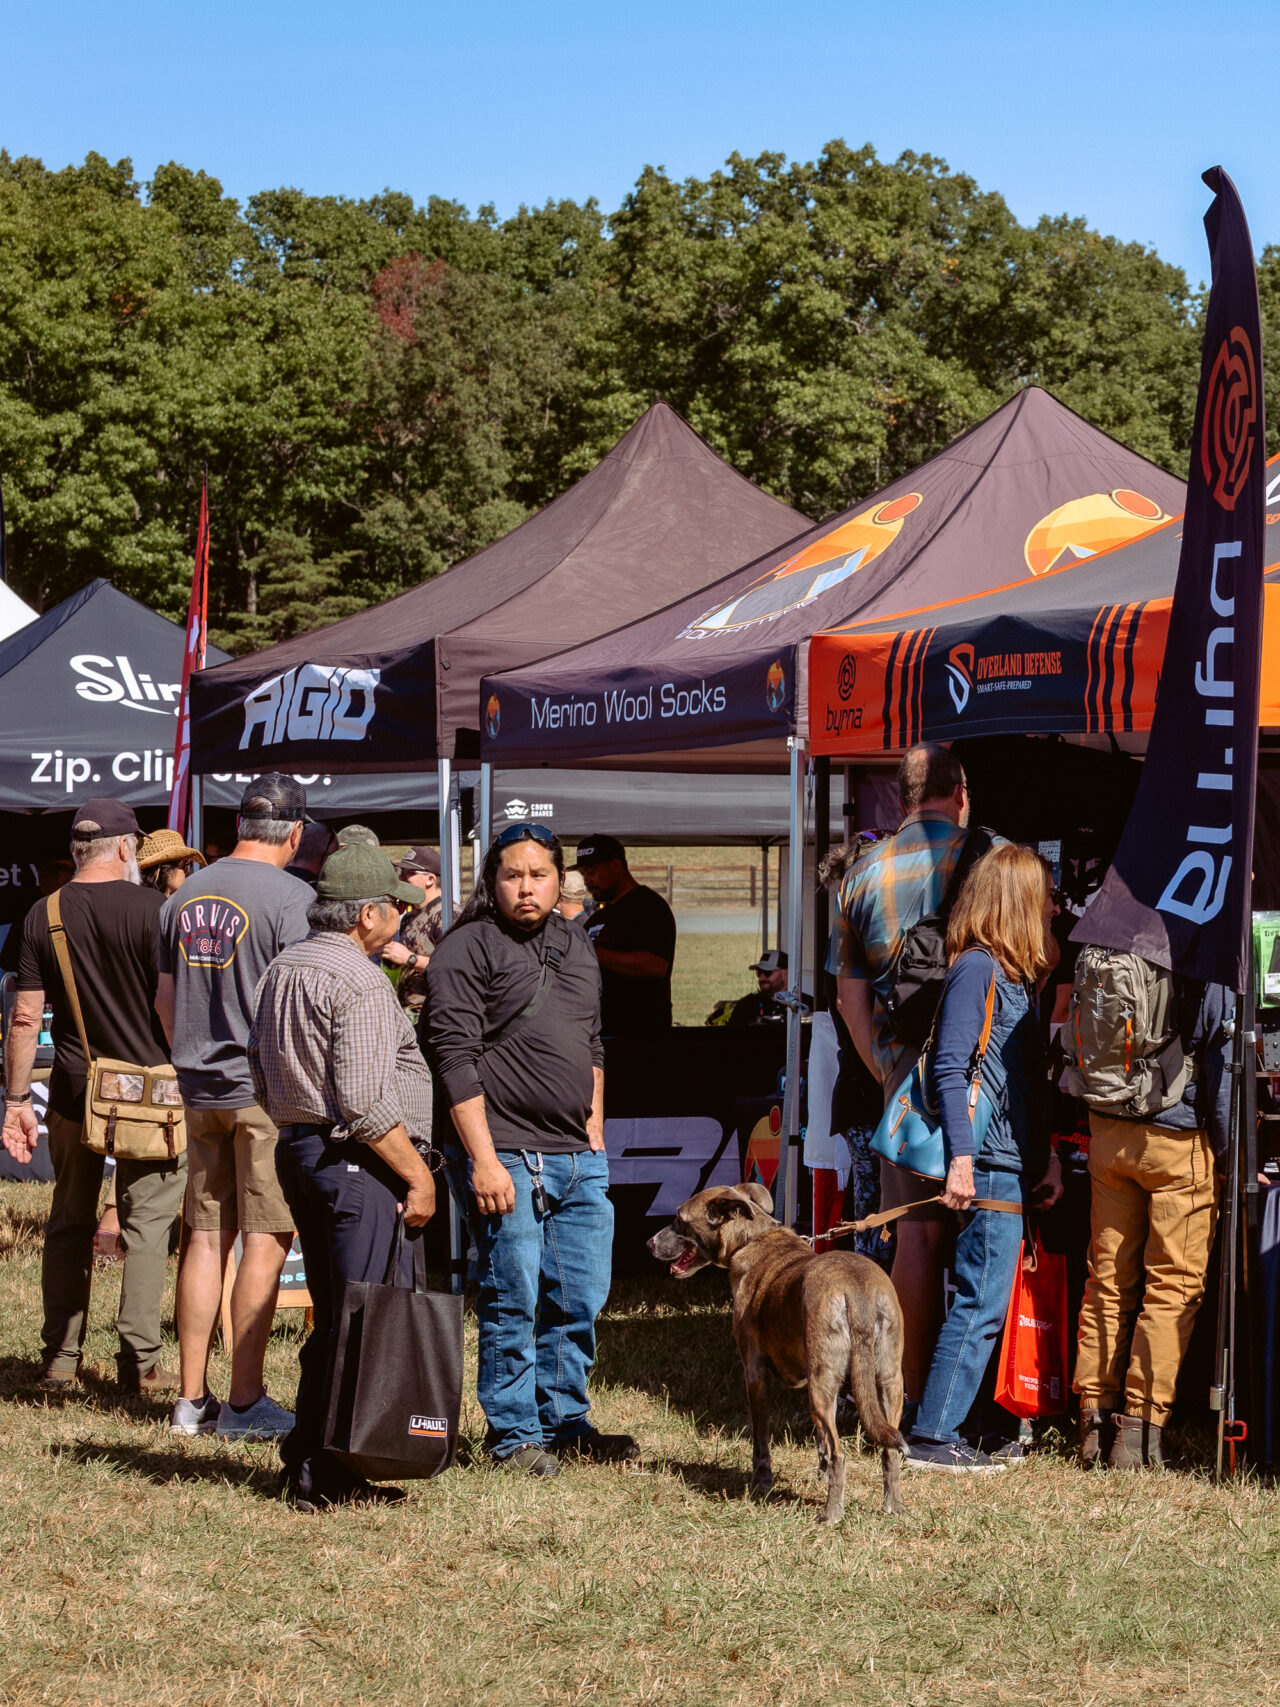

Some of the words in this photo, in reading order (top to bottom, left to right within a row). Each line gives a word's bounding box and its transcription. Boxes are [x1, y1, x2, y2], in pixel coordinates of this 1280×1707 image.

[976, 654, 1022, 681] OVERLAND
[1024, 652, 1063, 676] DEFENSE
[976, 680, 1032, 694] SMART-SAFE-PREPARED
[531, 696, 597, 730] Merino
[604, 686, 653, 724] Wool
[660, 679, 727, 718] Socks
[825, 702, 864, 737] byrna
[30, 749, 102, 793] Zip.
[530, 803, 554, 811] CROWN
[181, 903, 240, 937] ORVIS
